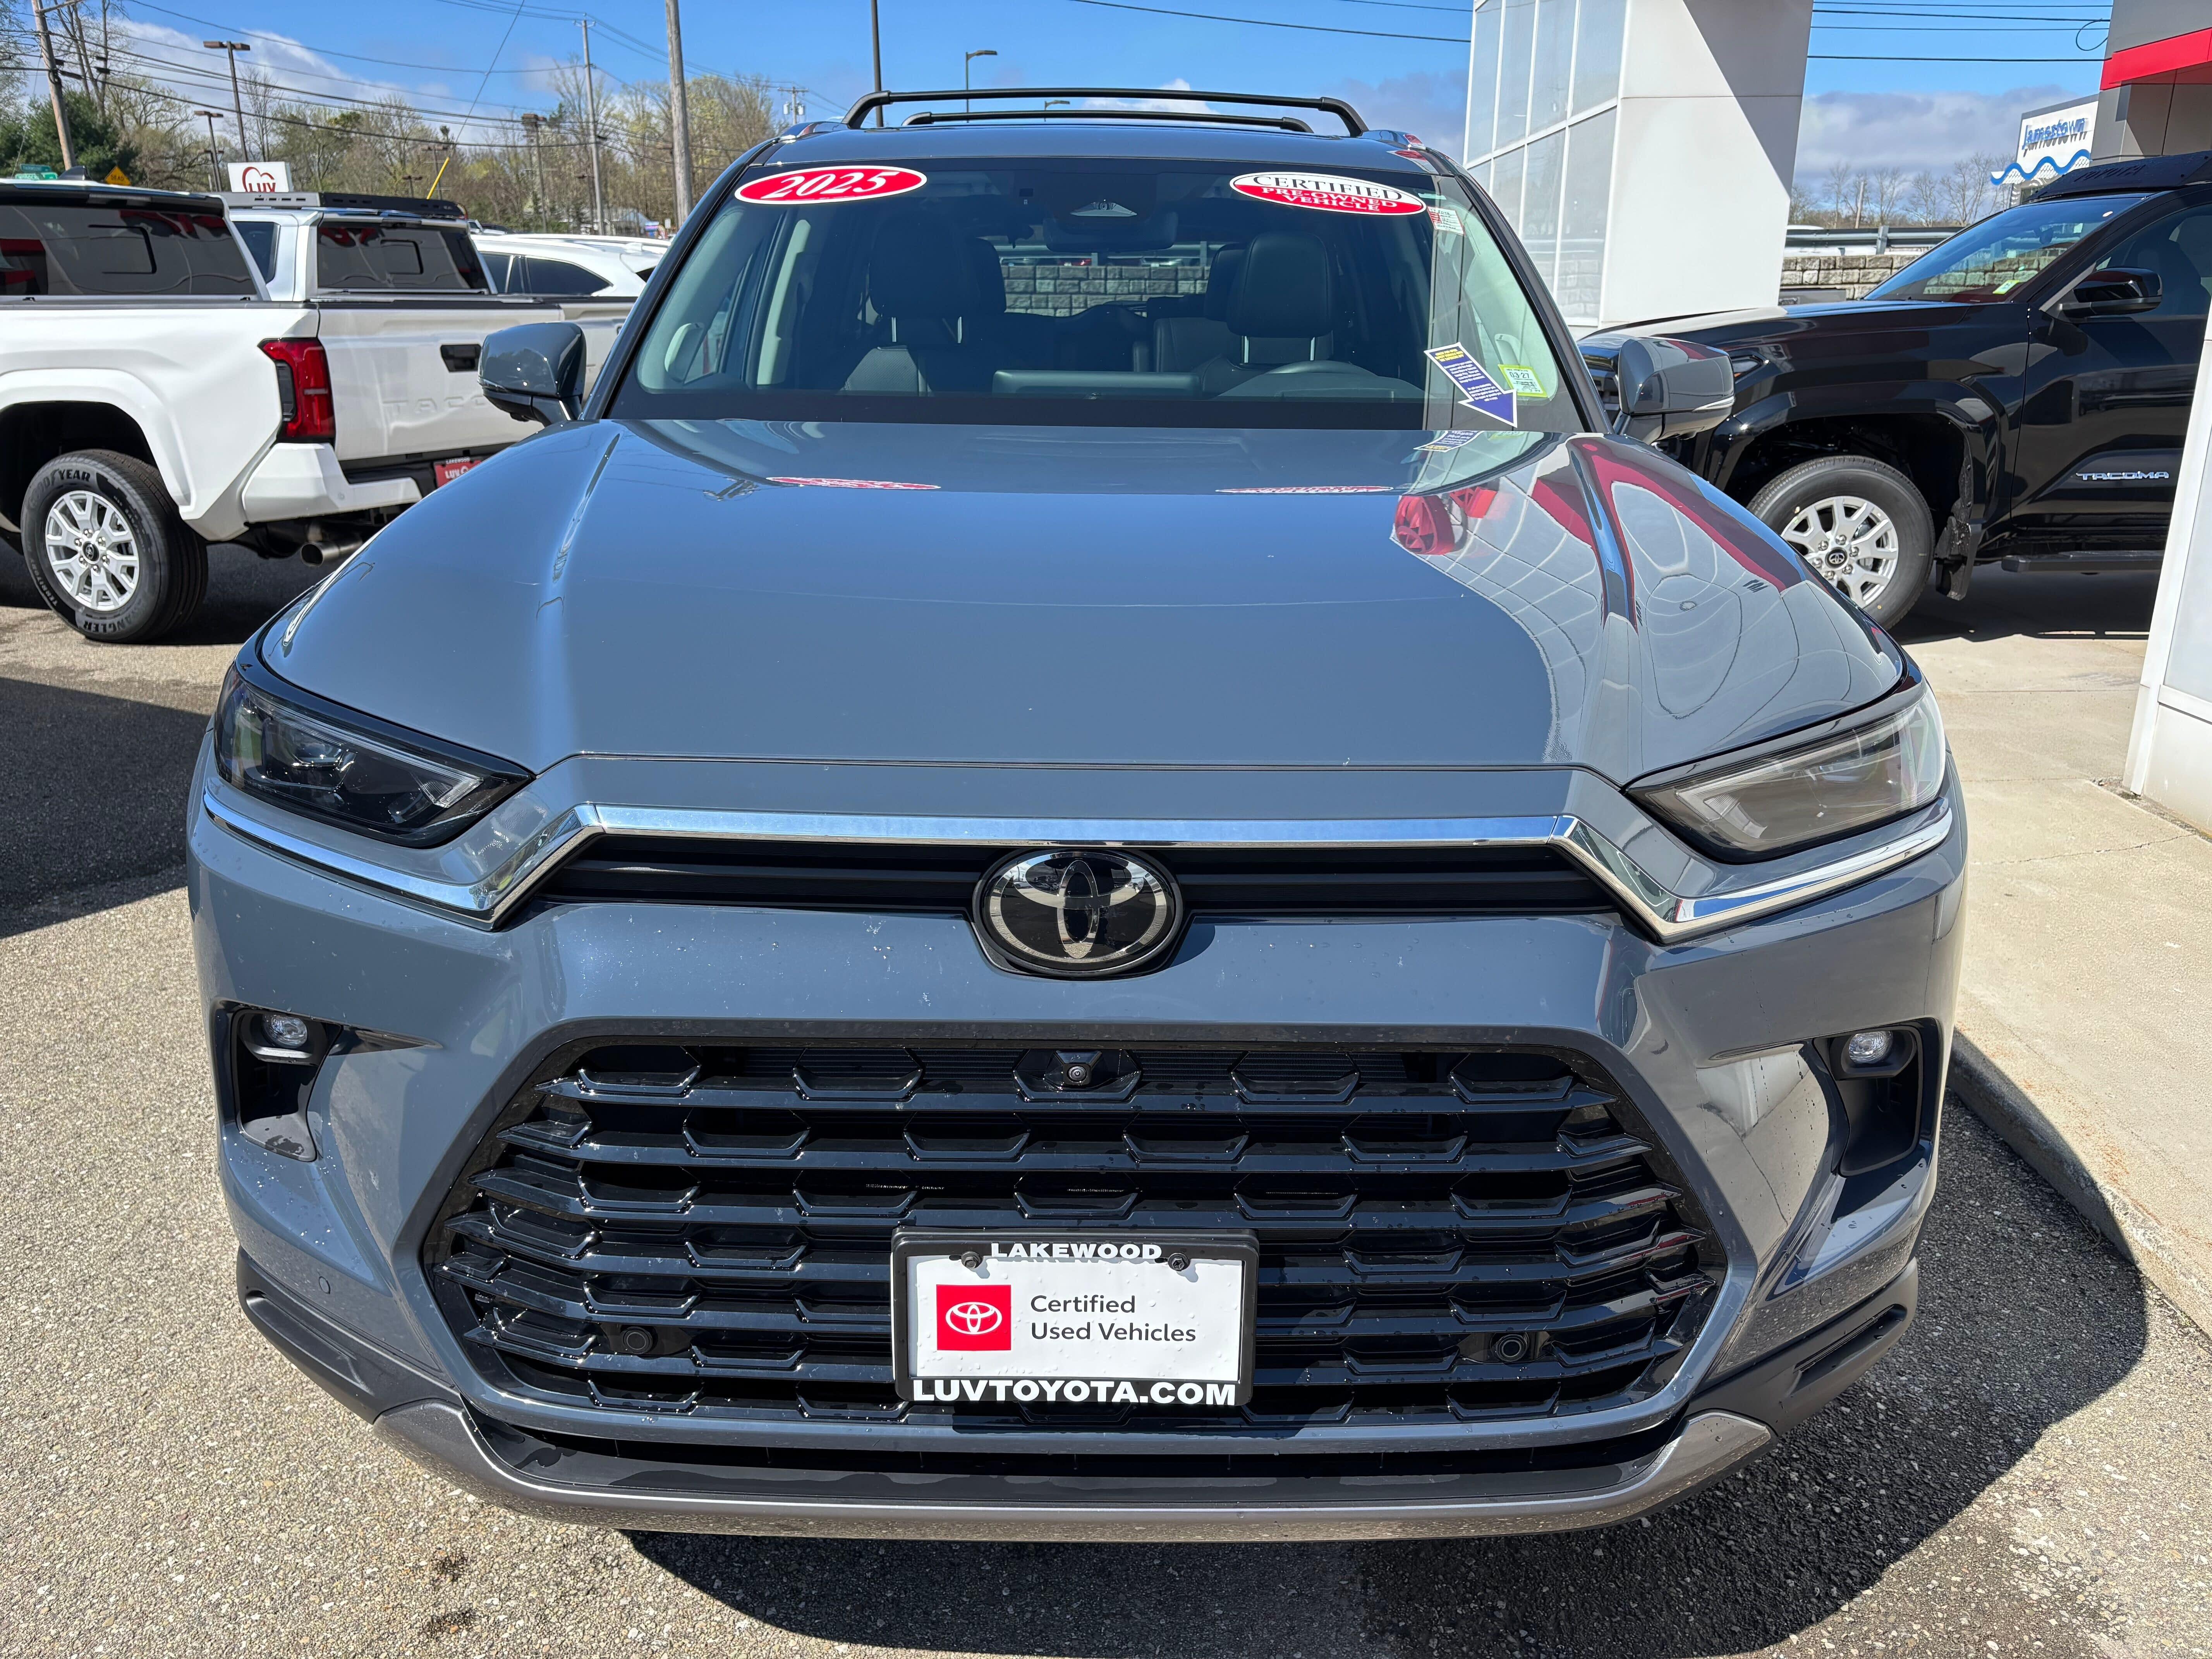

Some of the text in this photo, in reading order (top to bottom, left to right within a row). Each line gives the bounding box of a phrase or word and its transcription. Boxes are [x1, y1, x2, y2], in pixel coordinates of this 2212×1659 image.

[761, 171, 900, 199] 2025
[1253, 176, 1402, 200] CERTIFIED
[1262, 187, 1398, 208] PRE-OWNED
[1283, 195, 1380, 212] VEHICLE
[2076, 471, 2169, 480] TACOMA
[991, 1243, 1162, 1260] LAKEWOOD
[1030, 1295, 1135, 1313] Certified
[1032, 1322, 1196, 1342] Used Vehicles
[913, 1379, 1235, 1406] LUVTOYOTA.COM
